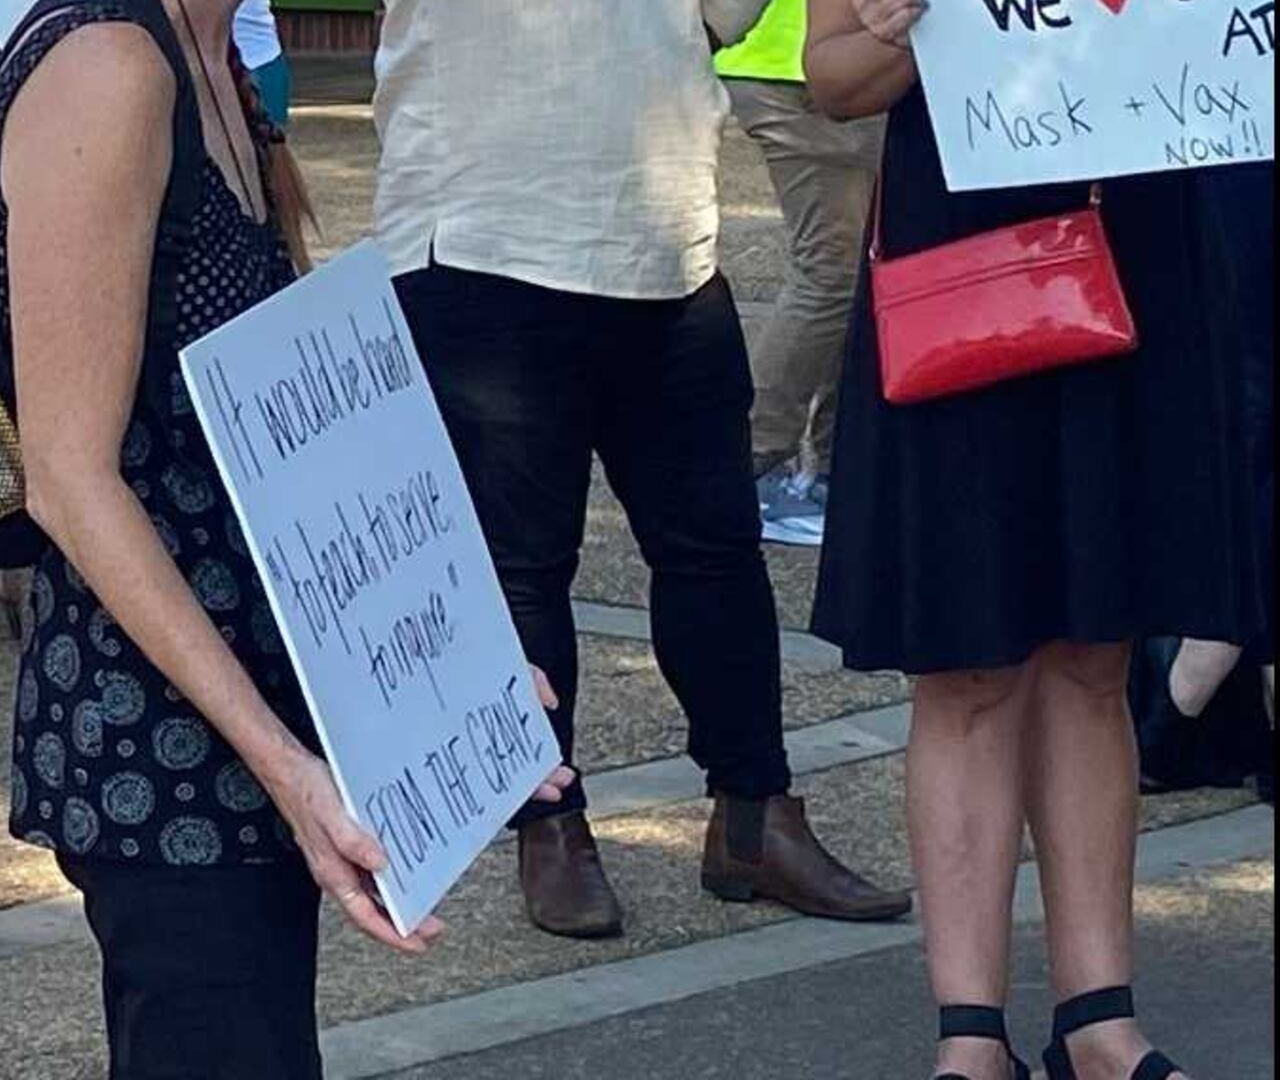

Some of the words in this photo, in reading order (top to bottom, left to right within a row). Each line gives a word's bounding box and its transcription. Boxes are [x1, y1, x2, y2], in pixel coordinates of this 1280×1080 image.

[963, 81, 1095, 152] Mask
[1152, 62, 1252, 126] Vax
[205, 354, 265, 484] It
[253, 330, 339, 461] would
[423, 734, 486, 828] THE
[464, 674, 544, 795] GRAVE
